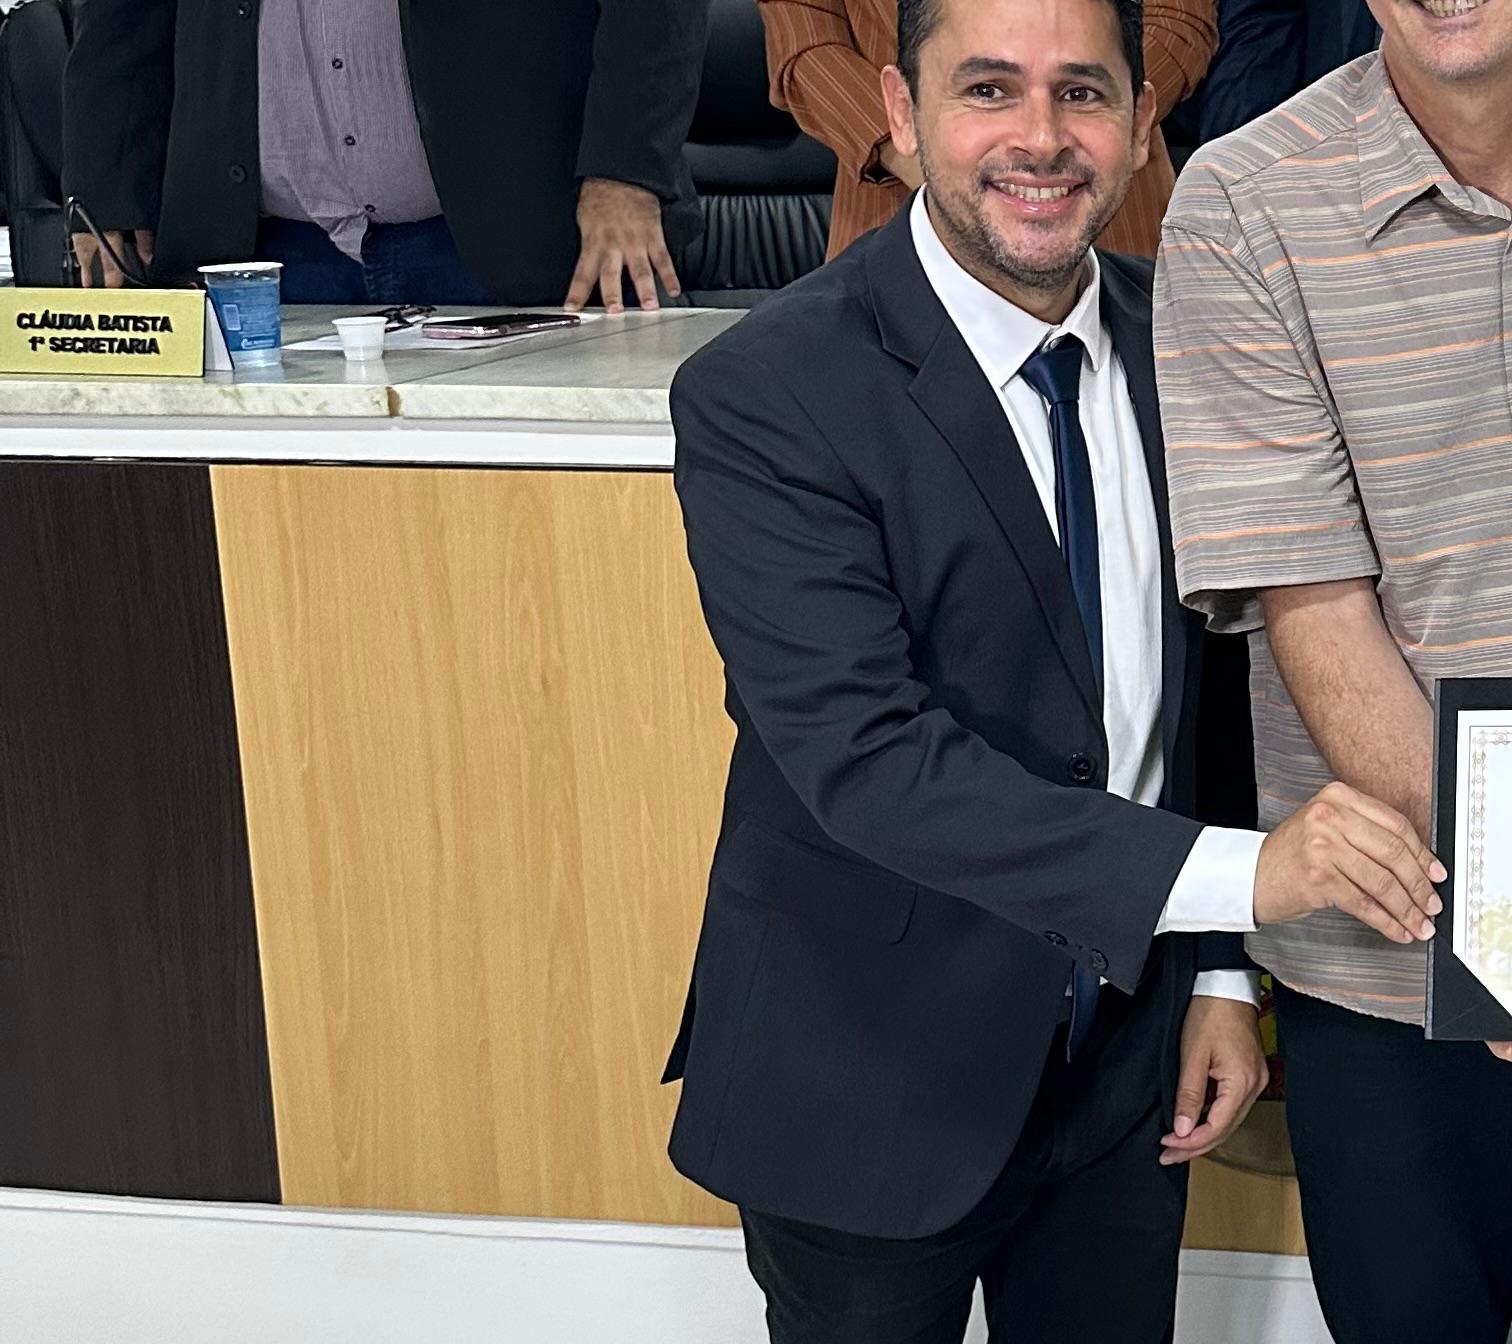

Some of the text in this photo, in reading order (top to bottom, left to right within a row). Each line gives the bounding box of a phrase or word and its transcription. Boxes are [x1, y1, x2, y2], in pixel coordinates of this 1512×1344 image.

[16, 309, 173, 333] CLÁUDIA BATISTA
[49, 336, 161, 354] SECRETARIA
